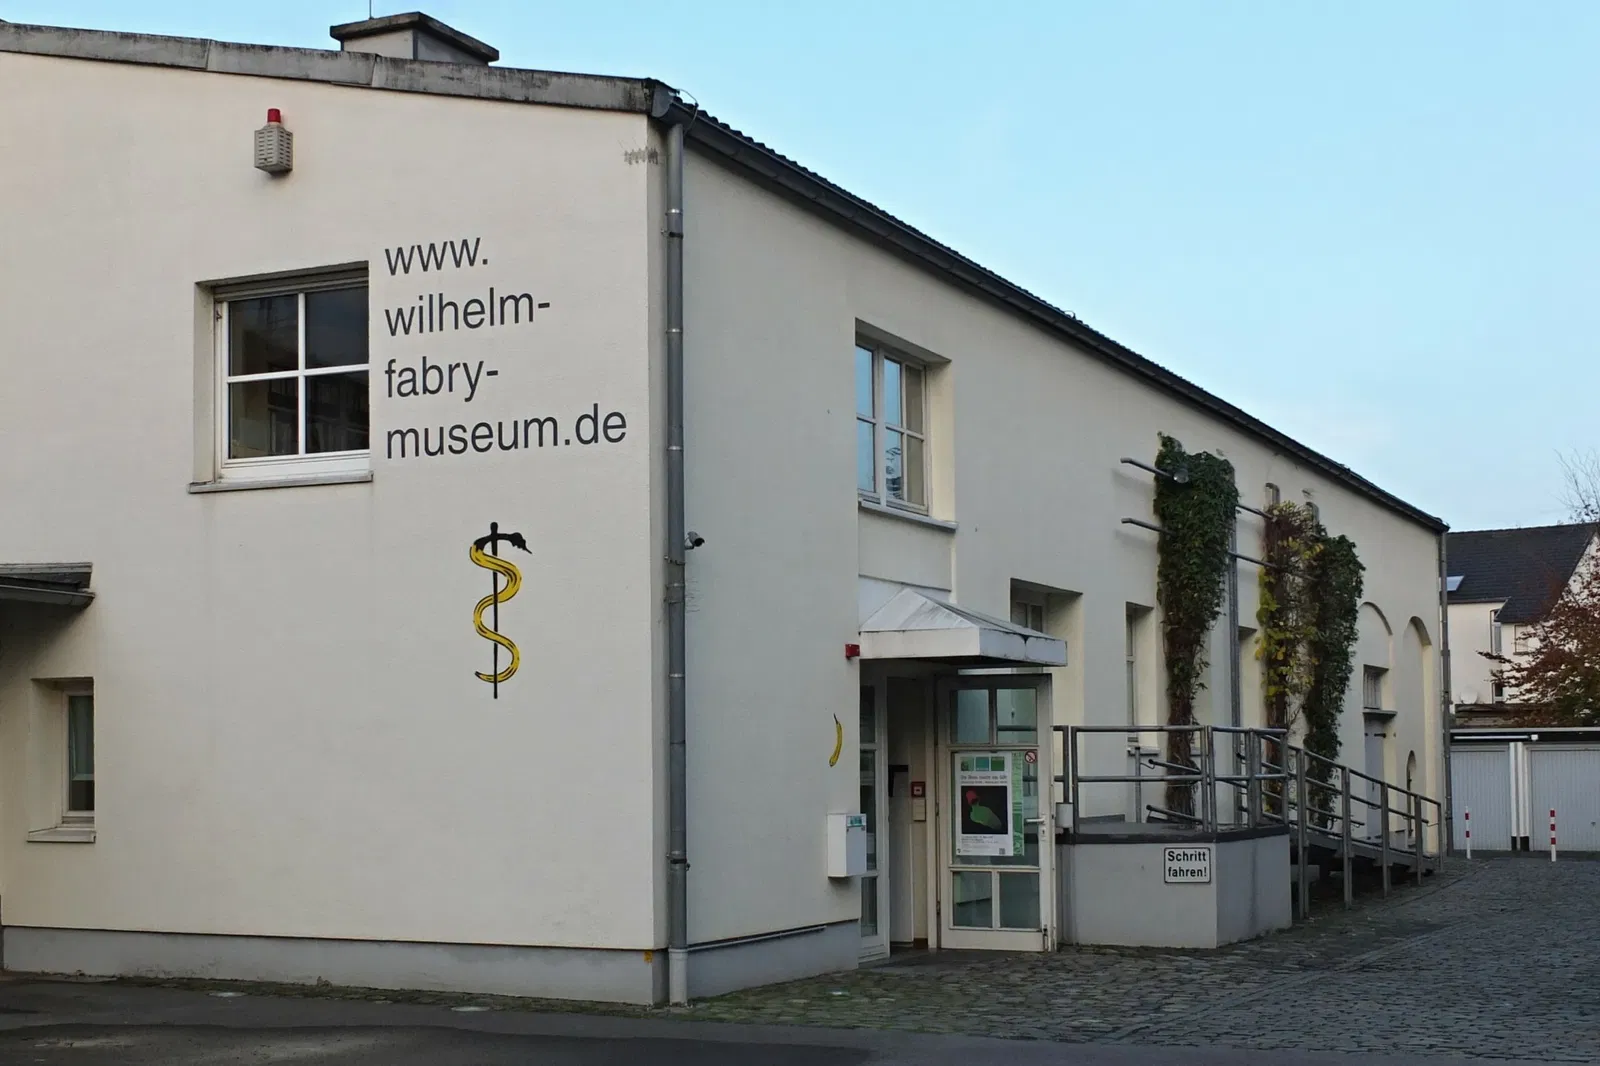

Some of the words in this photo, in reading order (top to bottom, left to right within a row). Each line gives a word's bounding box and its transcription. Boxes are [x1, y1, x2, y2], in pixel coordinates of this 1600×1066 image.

[384, 237, 489, 276] www.
[384, 287, 551, 337] wilhelm-
[384, 356, 499, 403] fabry-
[387, 403, 627, 460] museum.de
[1167, 850, 1207, 862] Schritt
[1167, 866, 1207, 878] fahren!
